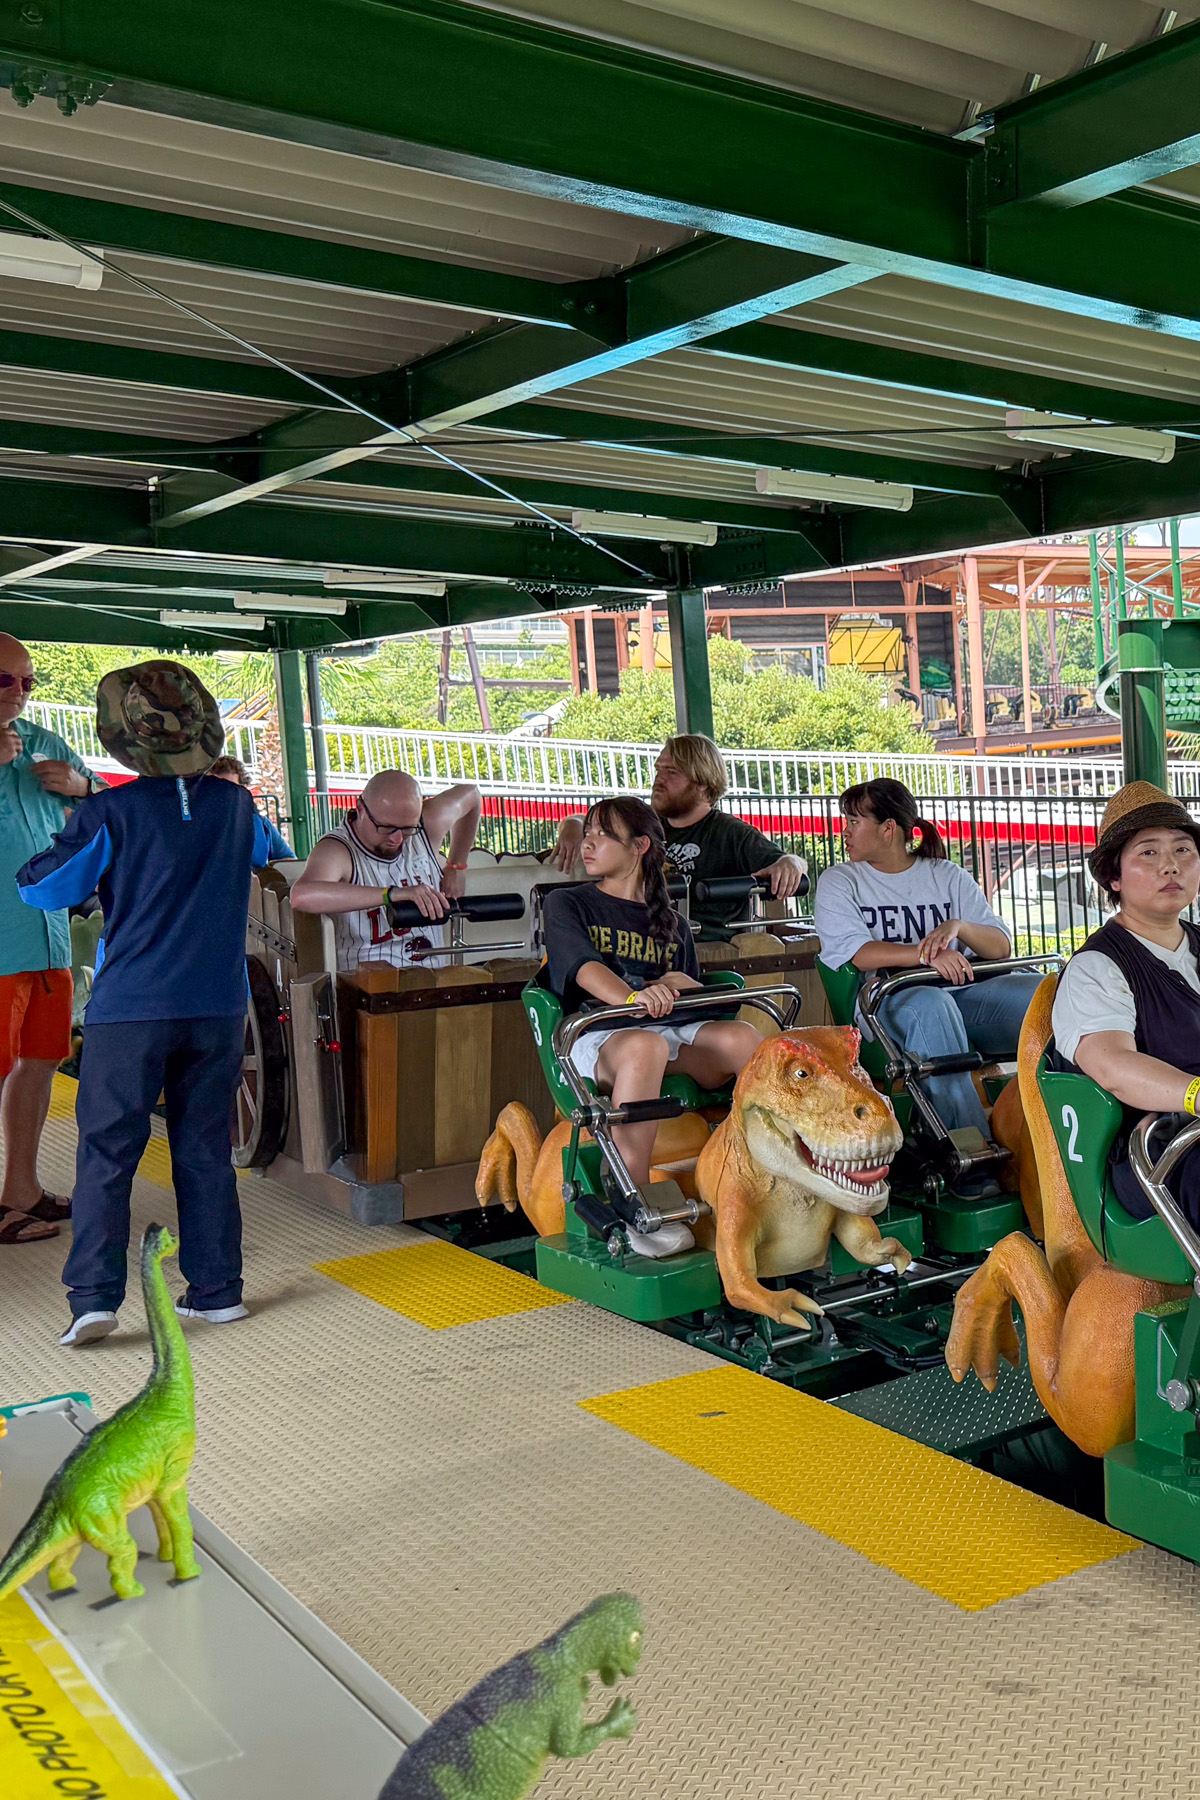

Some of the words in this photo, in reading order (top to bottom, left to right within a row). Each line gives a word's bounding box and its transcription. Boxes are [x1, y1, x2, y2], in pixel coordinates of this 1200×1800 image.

[529, 1006, 543, 1047] 3
[1061, 1104, 1084, 1163] 2
[1, 1703, 88, 1771] PHOTO
